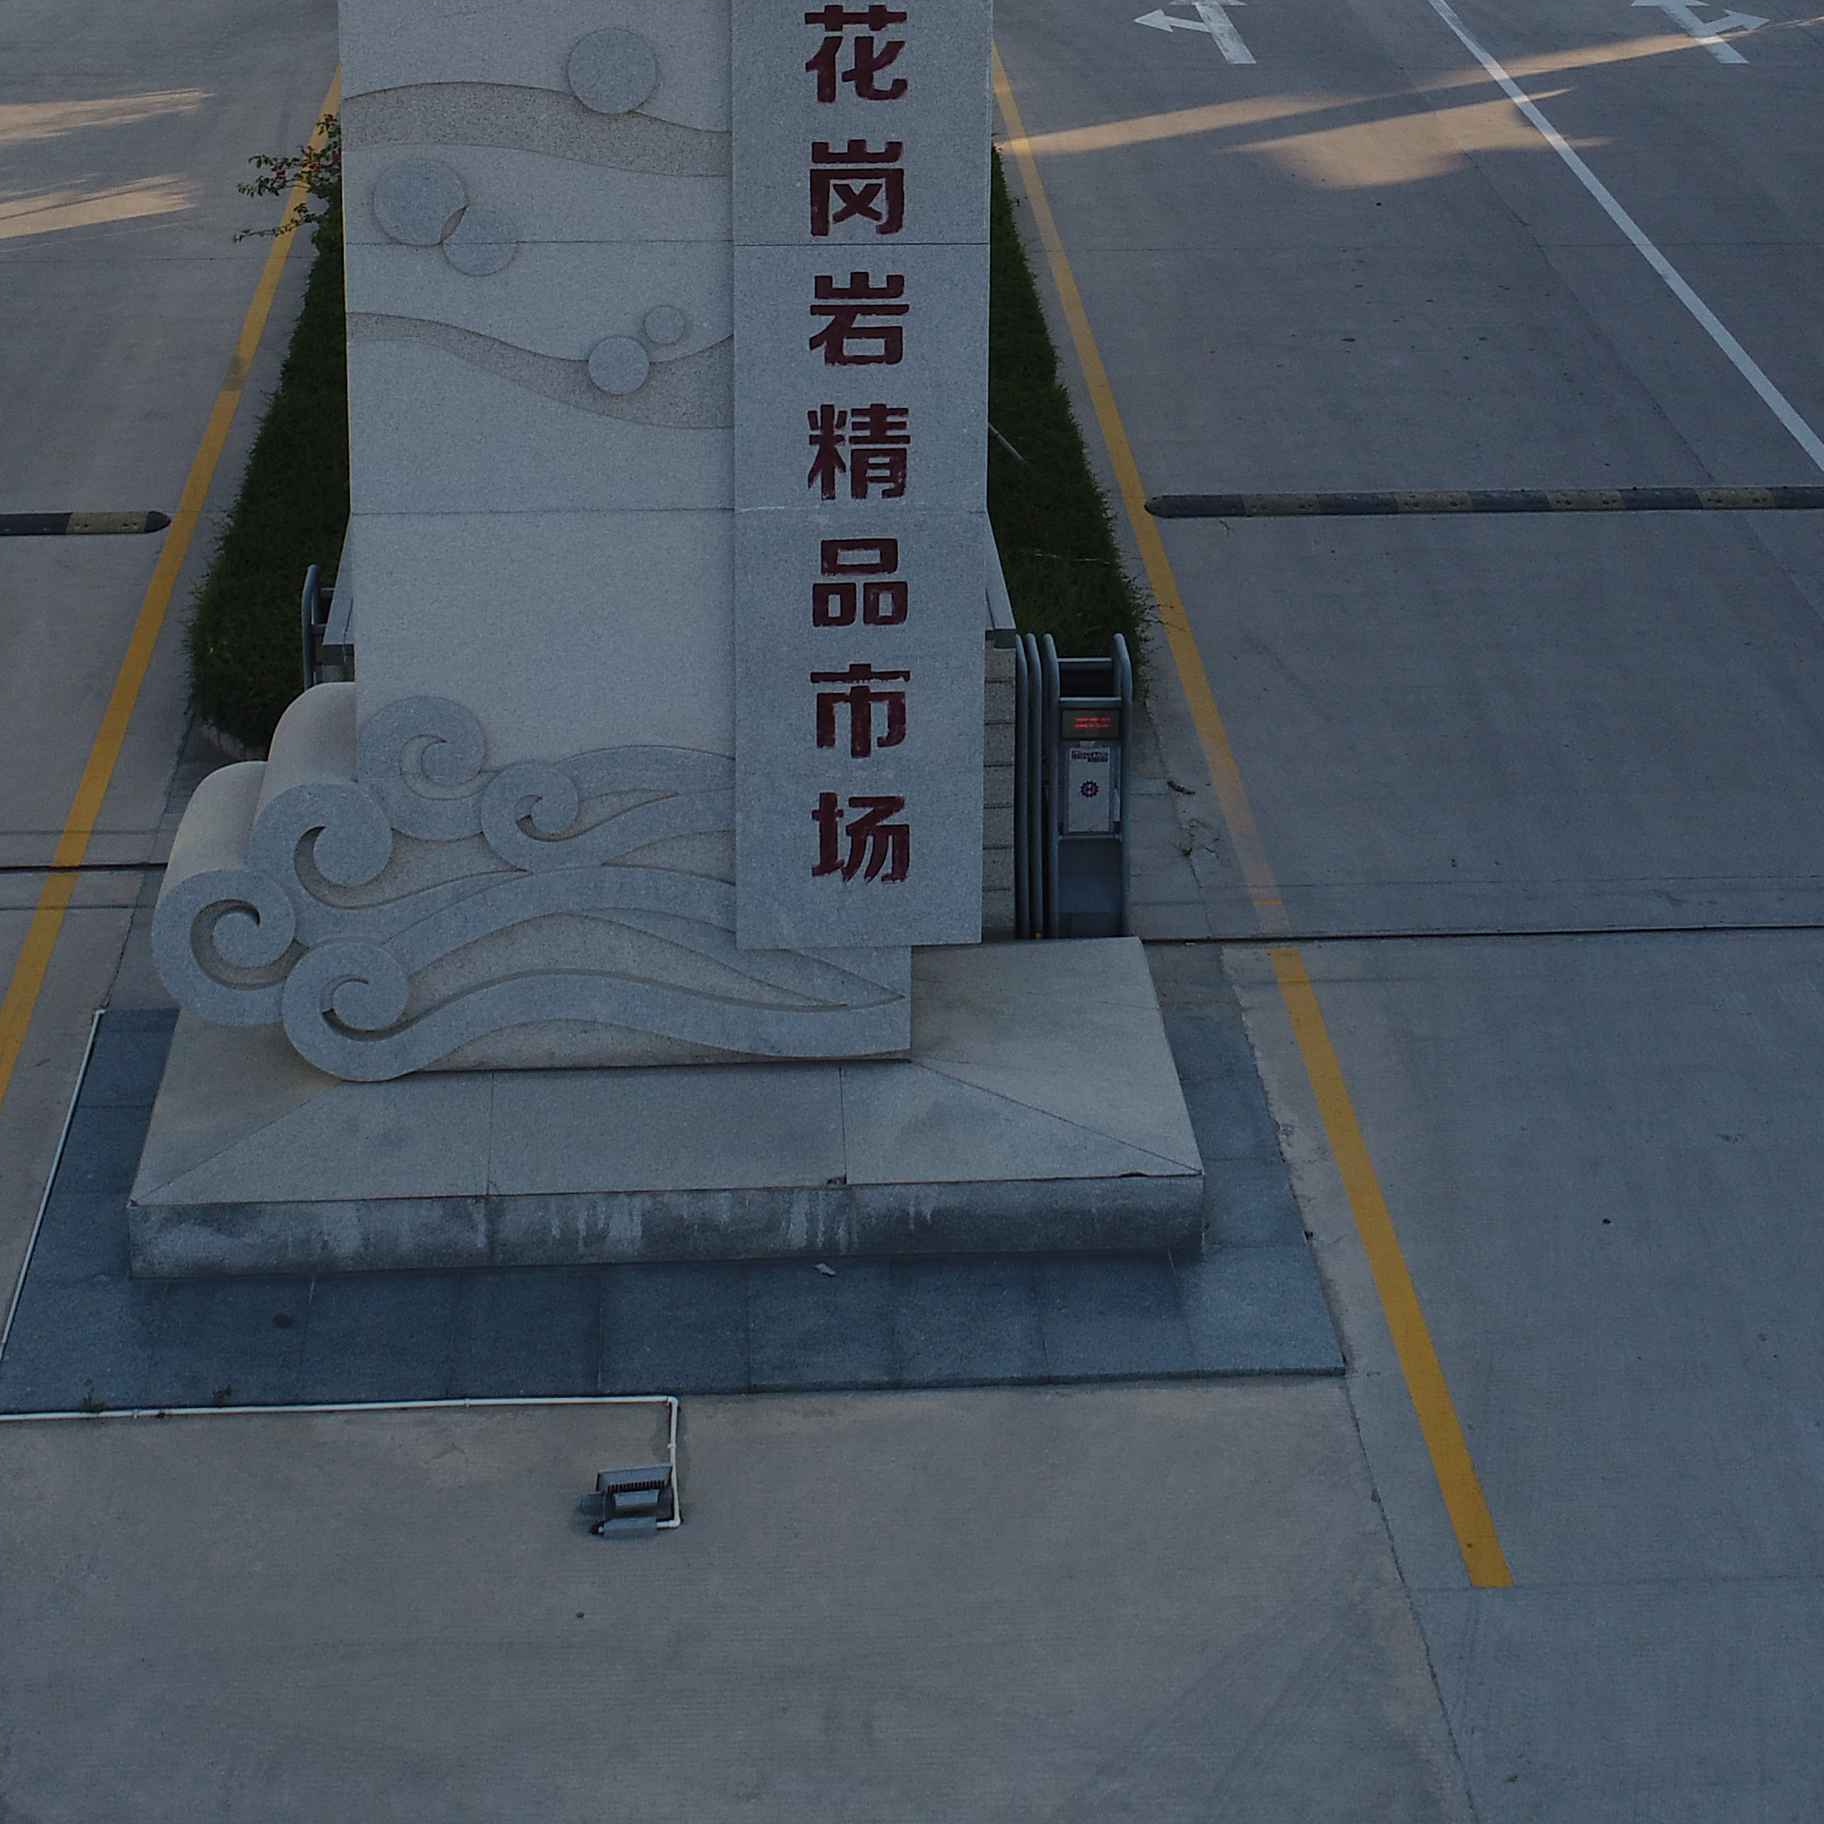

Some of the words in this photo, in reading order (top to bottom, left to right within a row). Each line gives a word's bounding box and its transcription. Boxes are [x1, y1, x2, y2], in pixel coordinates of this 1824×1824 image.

[804, 4, 912, 883] 花岗岩精品市场
